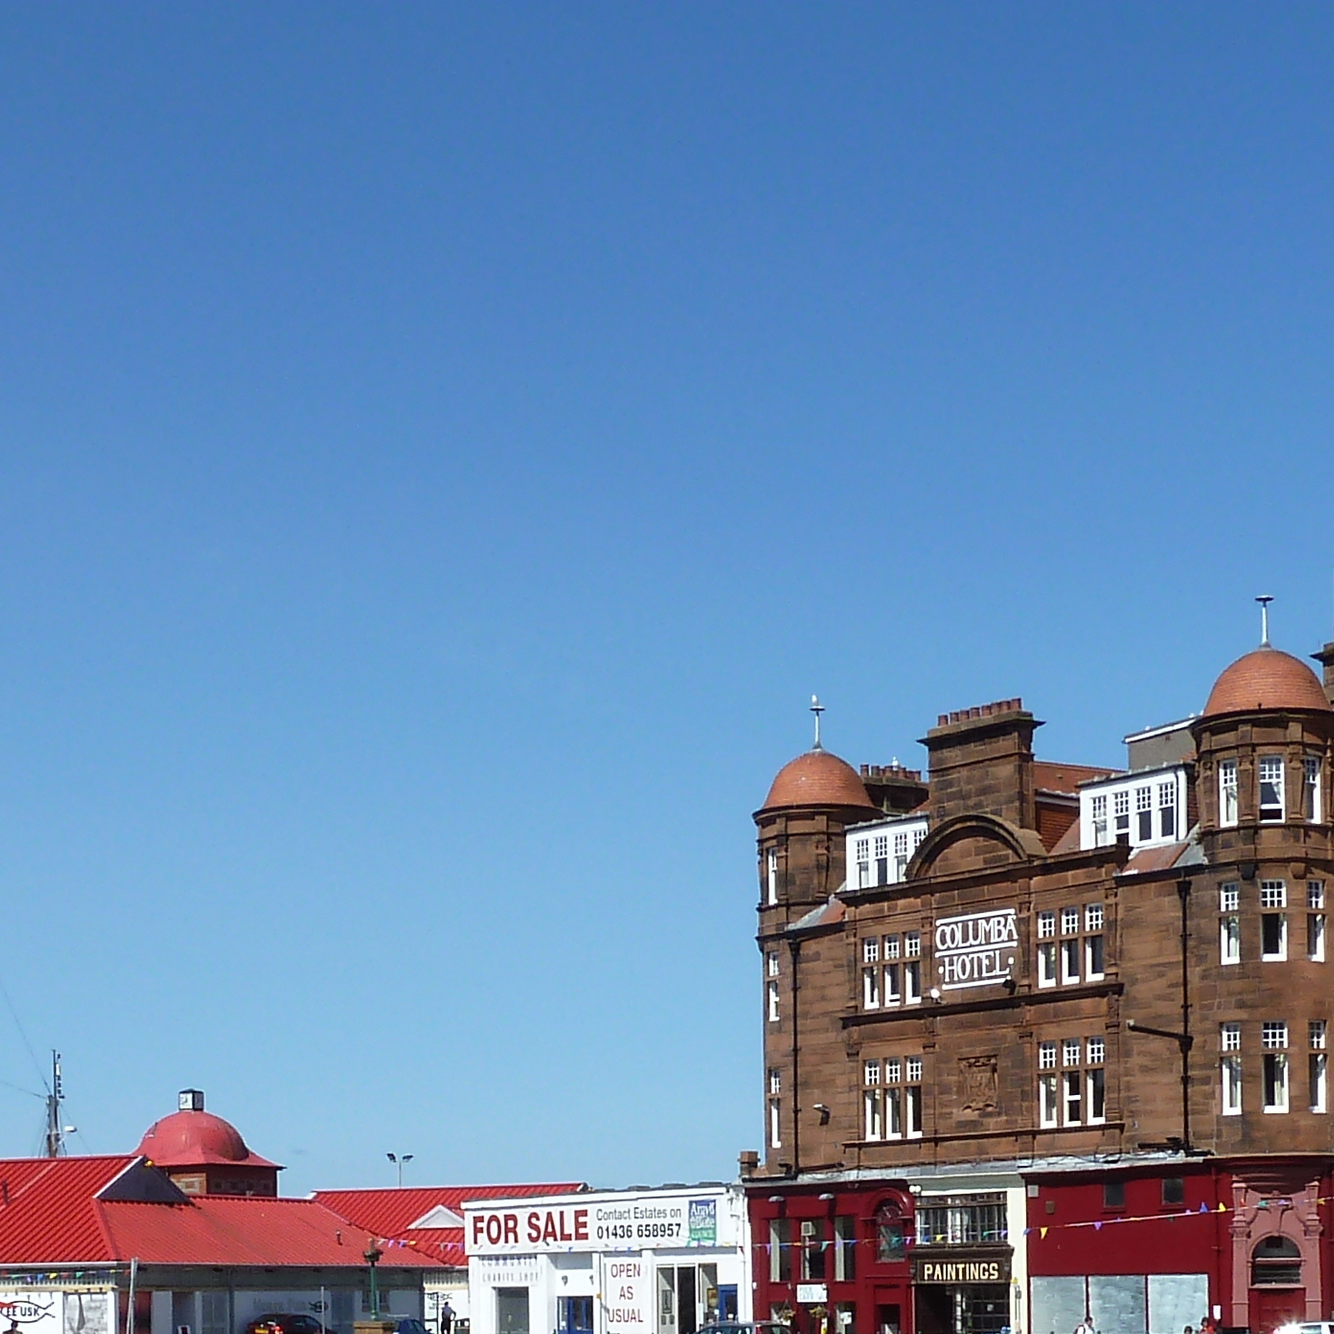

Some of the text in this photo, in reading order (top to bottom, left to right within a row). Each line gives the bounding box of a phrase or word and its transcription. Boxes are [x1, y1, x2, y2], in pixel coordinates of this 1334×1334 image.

[936, 916, 1018, 950] COLUMBA
[944, 950, 1009, 982] HOTEL
[596, 1206, 681, 1220] Contact Estates on
[473, 1209, 589, 1245] FOR SALE
[597, 1225, 633, 1239] 01436
[637, 1223, 682, 1238] 658957
[610, 1263, 641, 1278] OPEN
[924, 1262, 999, 1280] PAINTINGS
[619, 1285, 634, 1300] AS
[608, 1308, 644, 1323] USUAL
